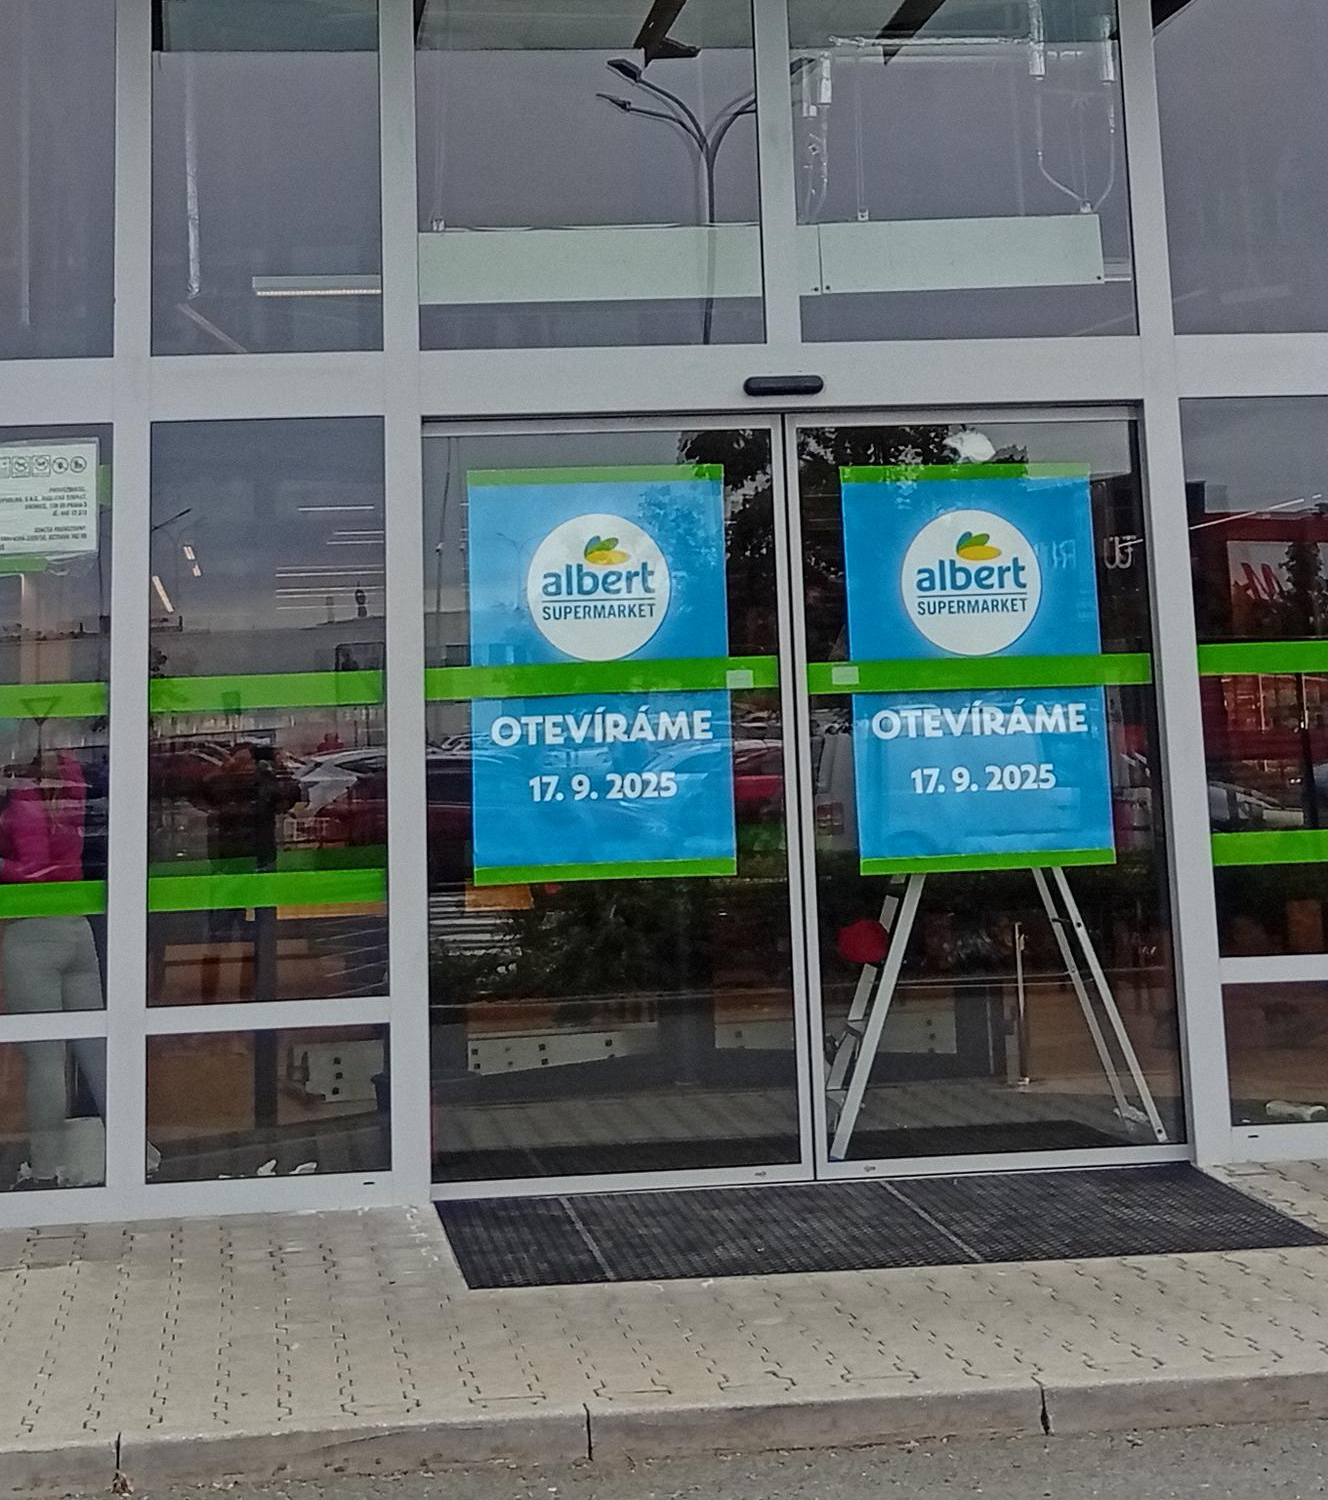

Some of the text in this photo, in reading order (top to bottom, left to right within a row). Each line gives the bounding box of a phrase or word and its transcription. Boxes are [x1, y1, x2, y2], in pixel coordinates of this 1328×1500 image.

[542, 562, 656, 597] albert
[916, 557, 1028, 592] albert
[542, 603, 657, 621] SUPERMARKET
[917, 597, 1029, 616] SUPERMARKET
[490, 706, 714, 747] OTEVÍRÁME
[871, 698, 1089, 740] OTEVÍRÁME
[529, 772, 678, 802] 17. 9. 2025
[910, 763, 1057, 794] 17. 9. 2025
